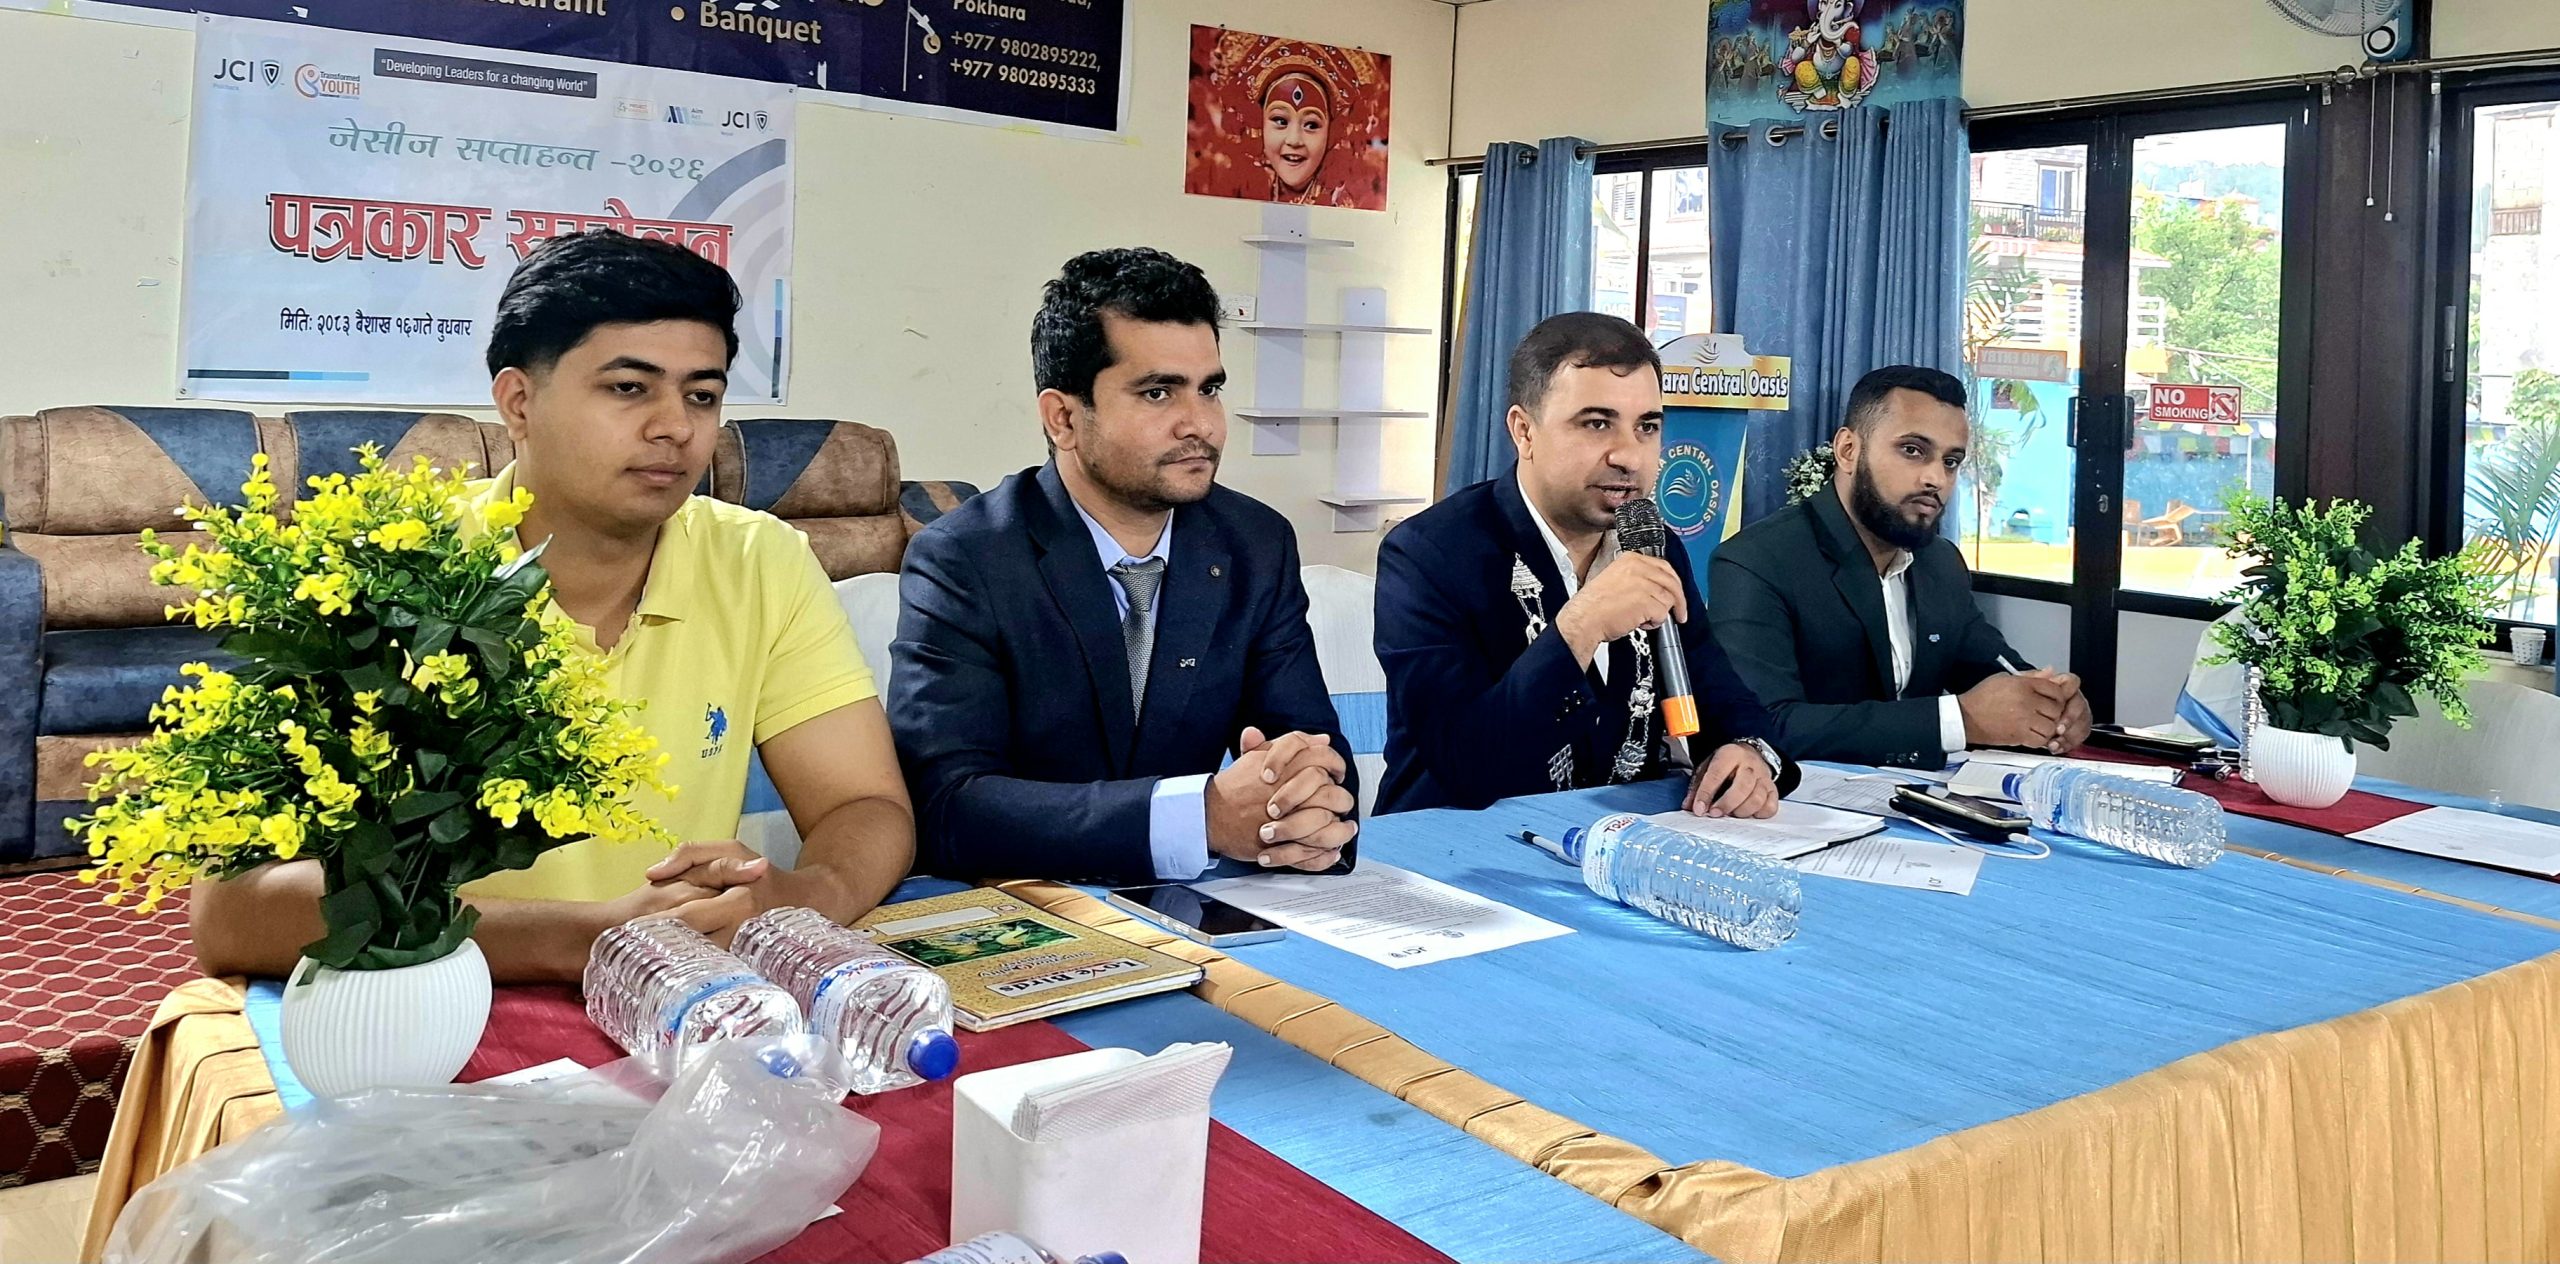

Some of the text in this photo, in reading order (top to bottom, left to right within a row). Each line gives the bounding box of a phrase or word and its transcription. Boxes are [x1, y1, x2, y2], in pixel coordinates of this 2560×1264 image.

[699, 3, 822, 44] Banquet
[951, 31, 1101, 72] +977 9802895222,
[214, 58, 254, 82] JCI
[445, 65, 484, 81] Leaders
[486, 71, 500, 82] for
[502, 74, 508, 83] a
[511, 72, 554, 90] changing
[950, 58, 1096, 95] +977 9802895333
[320, 79, 360, 95] YOUTH
[722, 111, 750, 129] JCI
[328, 117, 443, 158] जेसीज
[266, 193, 492, 269] पत्रकार
[317, 314, 350, 336] २०८३
[1691, 367, 1747, 396] Central
[1749, 370, 1788, 397] Oasis
[2155, 389, 2185, 405] NO
[2155, 406, 2209, 420] SMOKING
[1668, 444, 1720, 523] CENTRAL OASIS
[999, 973, 1075, 992] Birds
